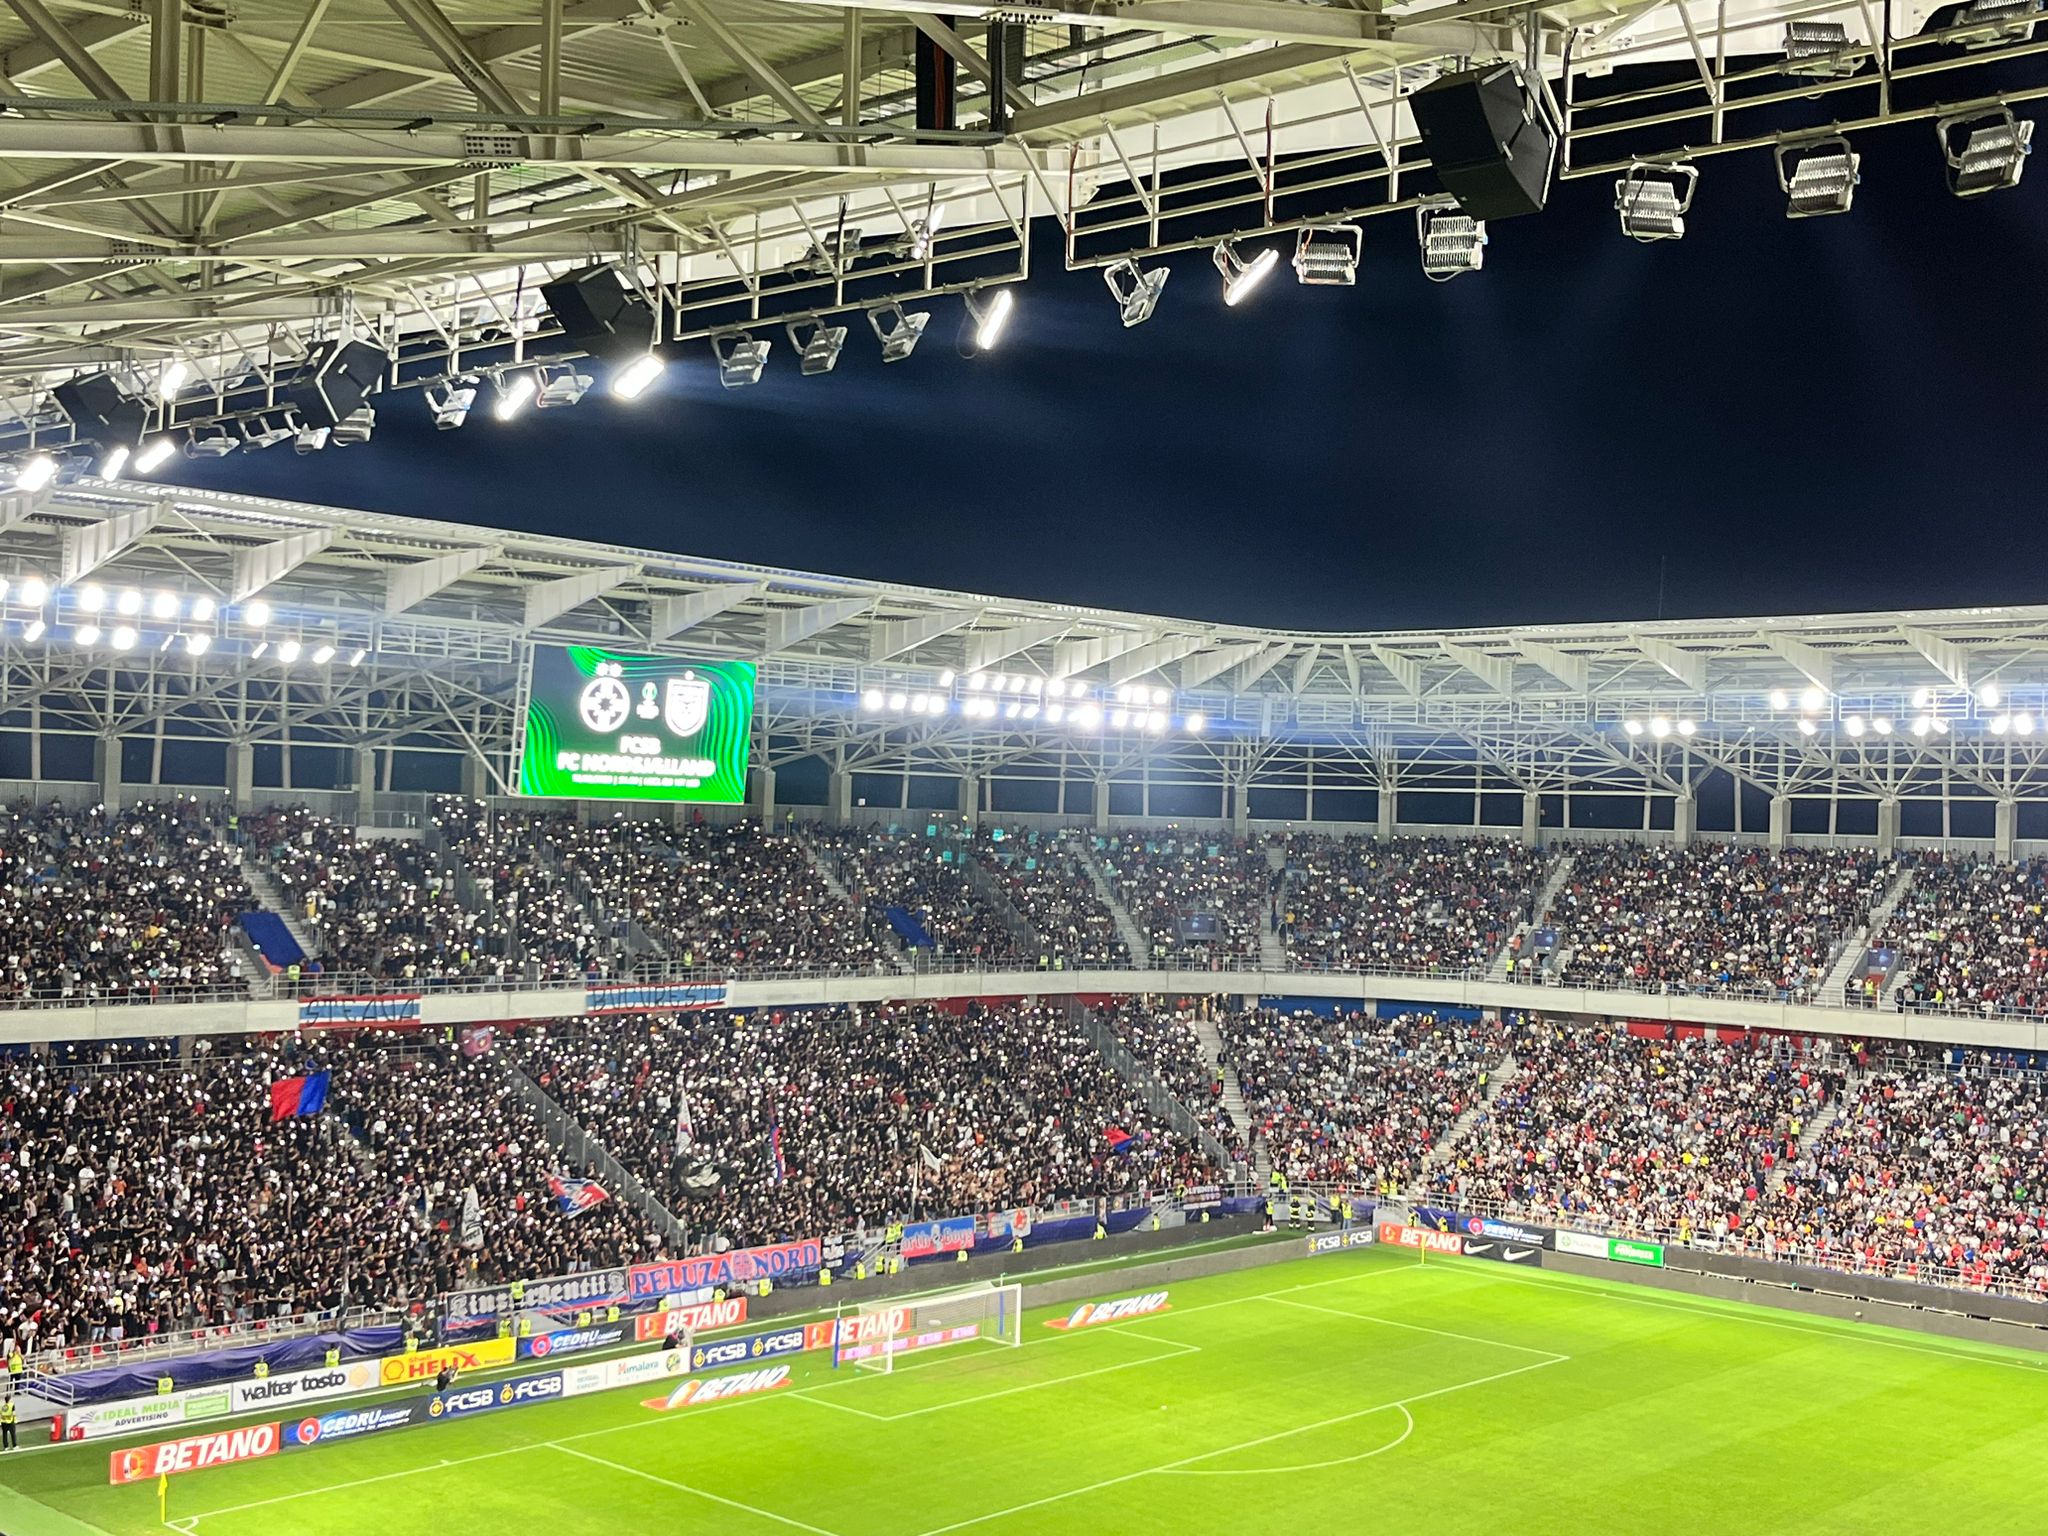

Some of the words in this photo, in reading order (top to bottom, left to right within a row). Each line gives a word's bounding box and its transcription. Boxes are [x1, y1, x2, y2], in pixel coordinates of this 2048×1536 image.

[1400, 1228, 1461, 1251] BETANO
[634, 1260, 734, 1294] PELUZA
[753, 1245, 817, 1276] NORD
[665, 1301, 740, 1334] BETANO
[1084, 1291, 1168, 1323] BETANO
[553, 1330, 599, 1348] CEDRU
[830, 1310, 904, 1344] BETANO
[706, 1343, 747, 1363] FCSB
[765, 1332, 803, 1352] FCSB
[409, 1351, 482, 1377] HELIX
[445, 1389, 493, 1412] FCSB
[515, 1377, 561, 1399] FCSB
[689, 1365, 790, 1403] BETANO
[103, 1407, 138, 1420] IDEAL
[142, 1400, 180, 1412] MEDIA
[114, 1412, 168, 1426] ADVERTISING
[323, 1410, 381, 1433] CEDRU
[154, 1425, 273, 1474] BETANO
